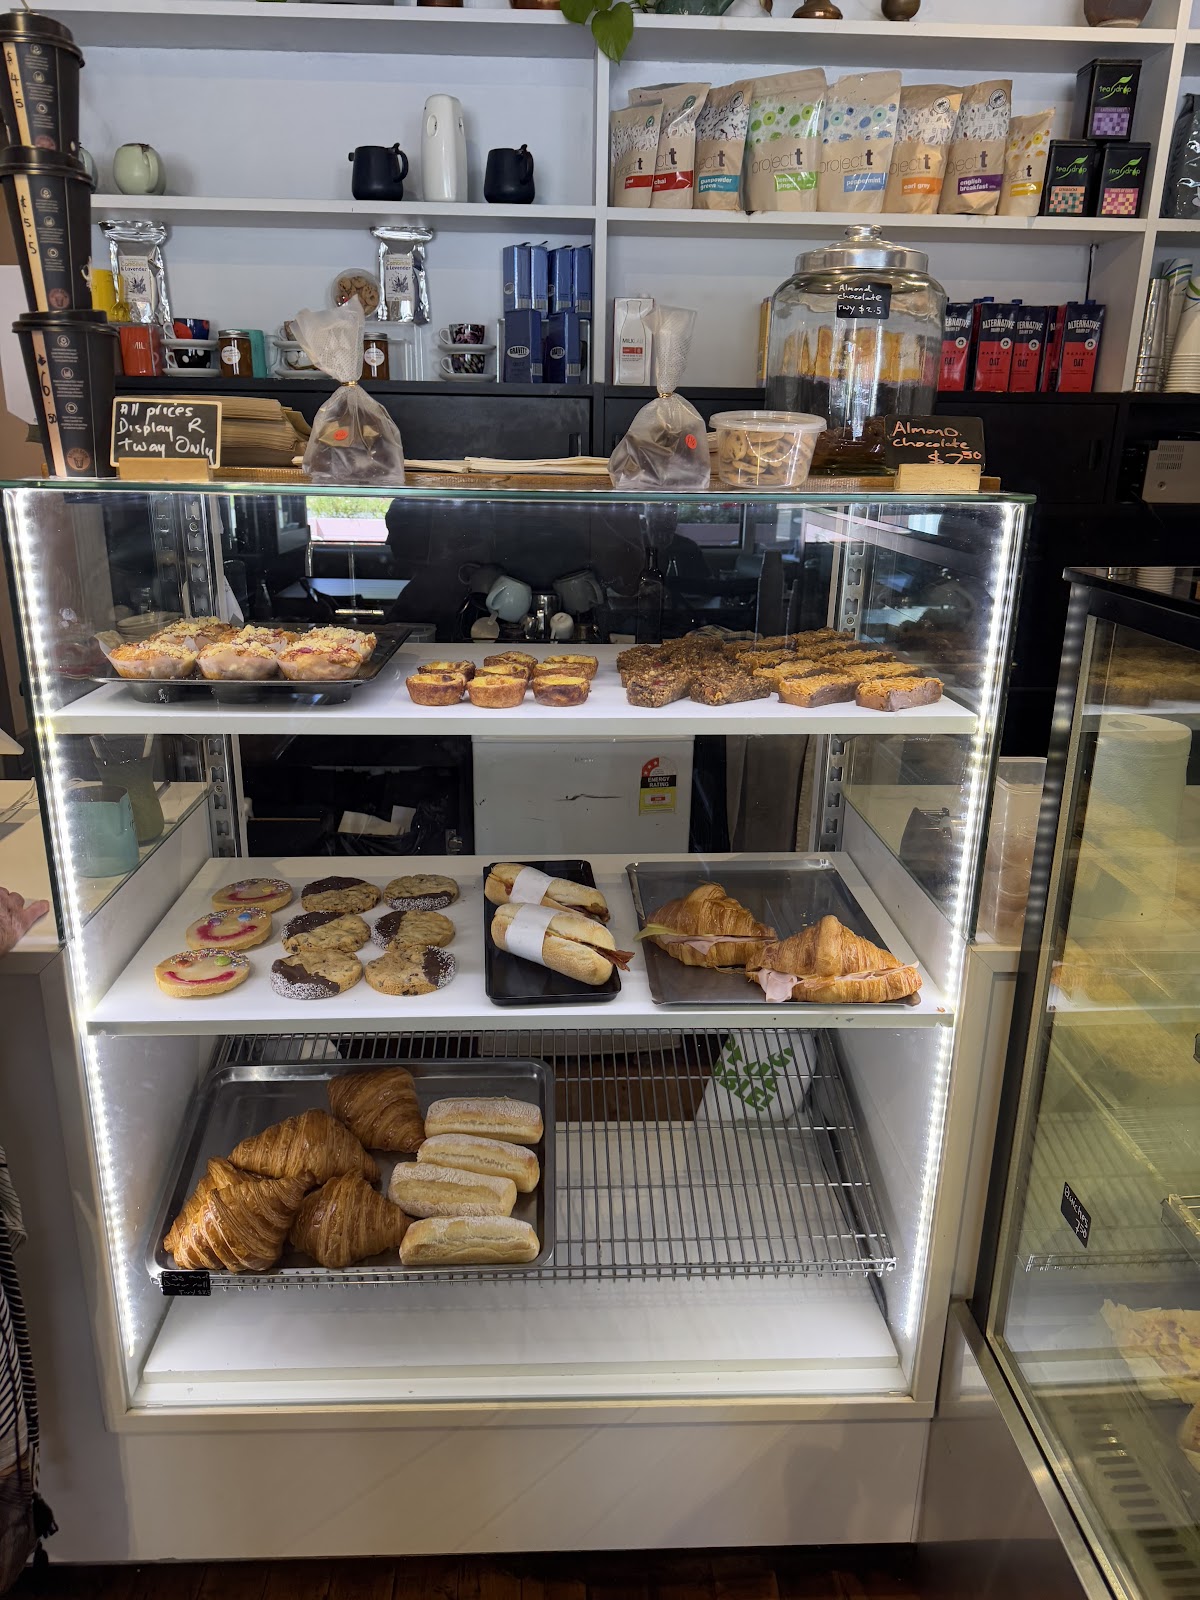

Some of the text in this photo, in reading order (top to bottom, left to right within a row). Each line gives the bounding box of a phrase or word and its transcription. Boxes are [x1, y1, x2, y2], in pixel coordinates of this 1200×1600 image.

[846, 177, 881, 186] peppermint
[917, 183, 931, 191] grey
[960, 178, 982, 186] english
[960, 183, 988, 192] breakfast
[838, 283, 872, 293] Almond
[945, 317, 971, 329] ERNATIVE
[982, 318, 1016, 330] ALTERNATIVE
[1067, 319, 1101, 331] ALTERNATIVE
[120, 402, 193, 425] All prices
[116, 417, 205, 442] Display R
